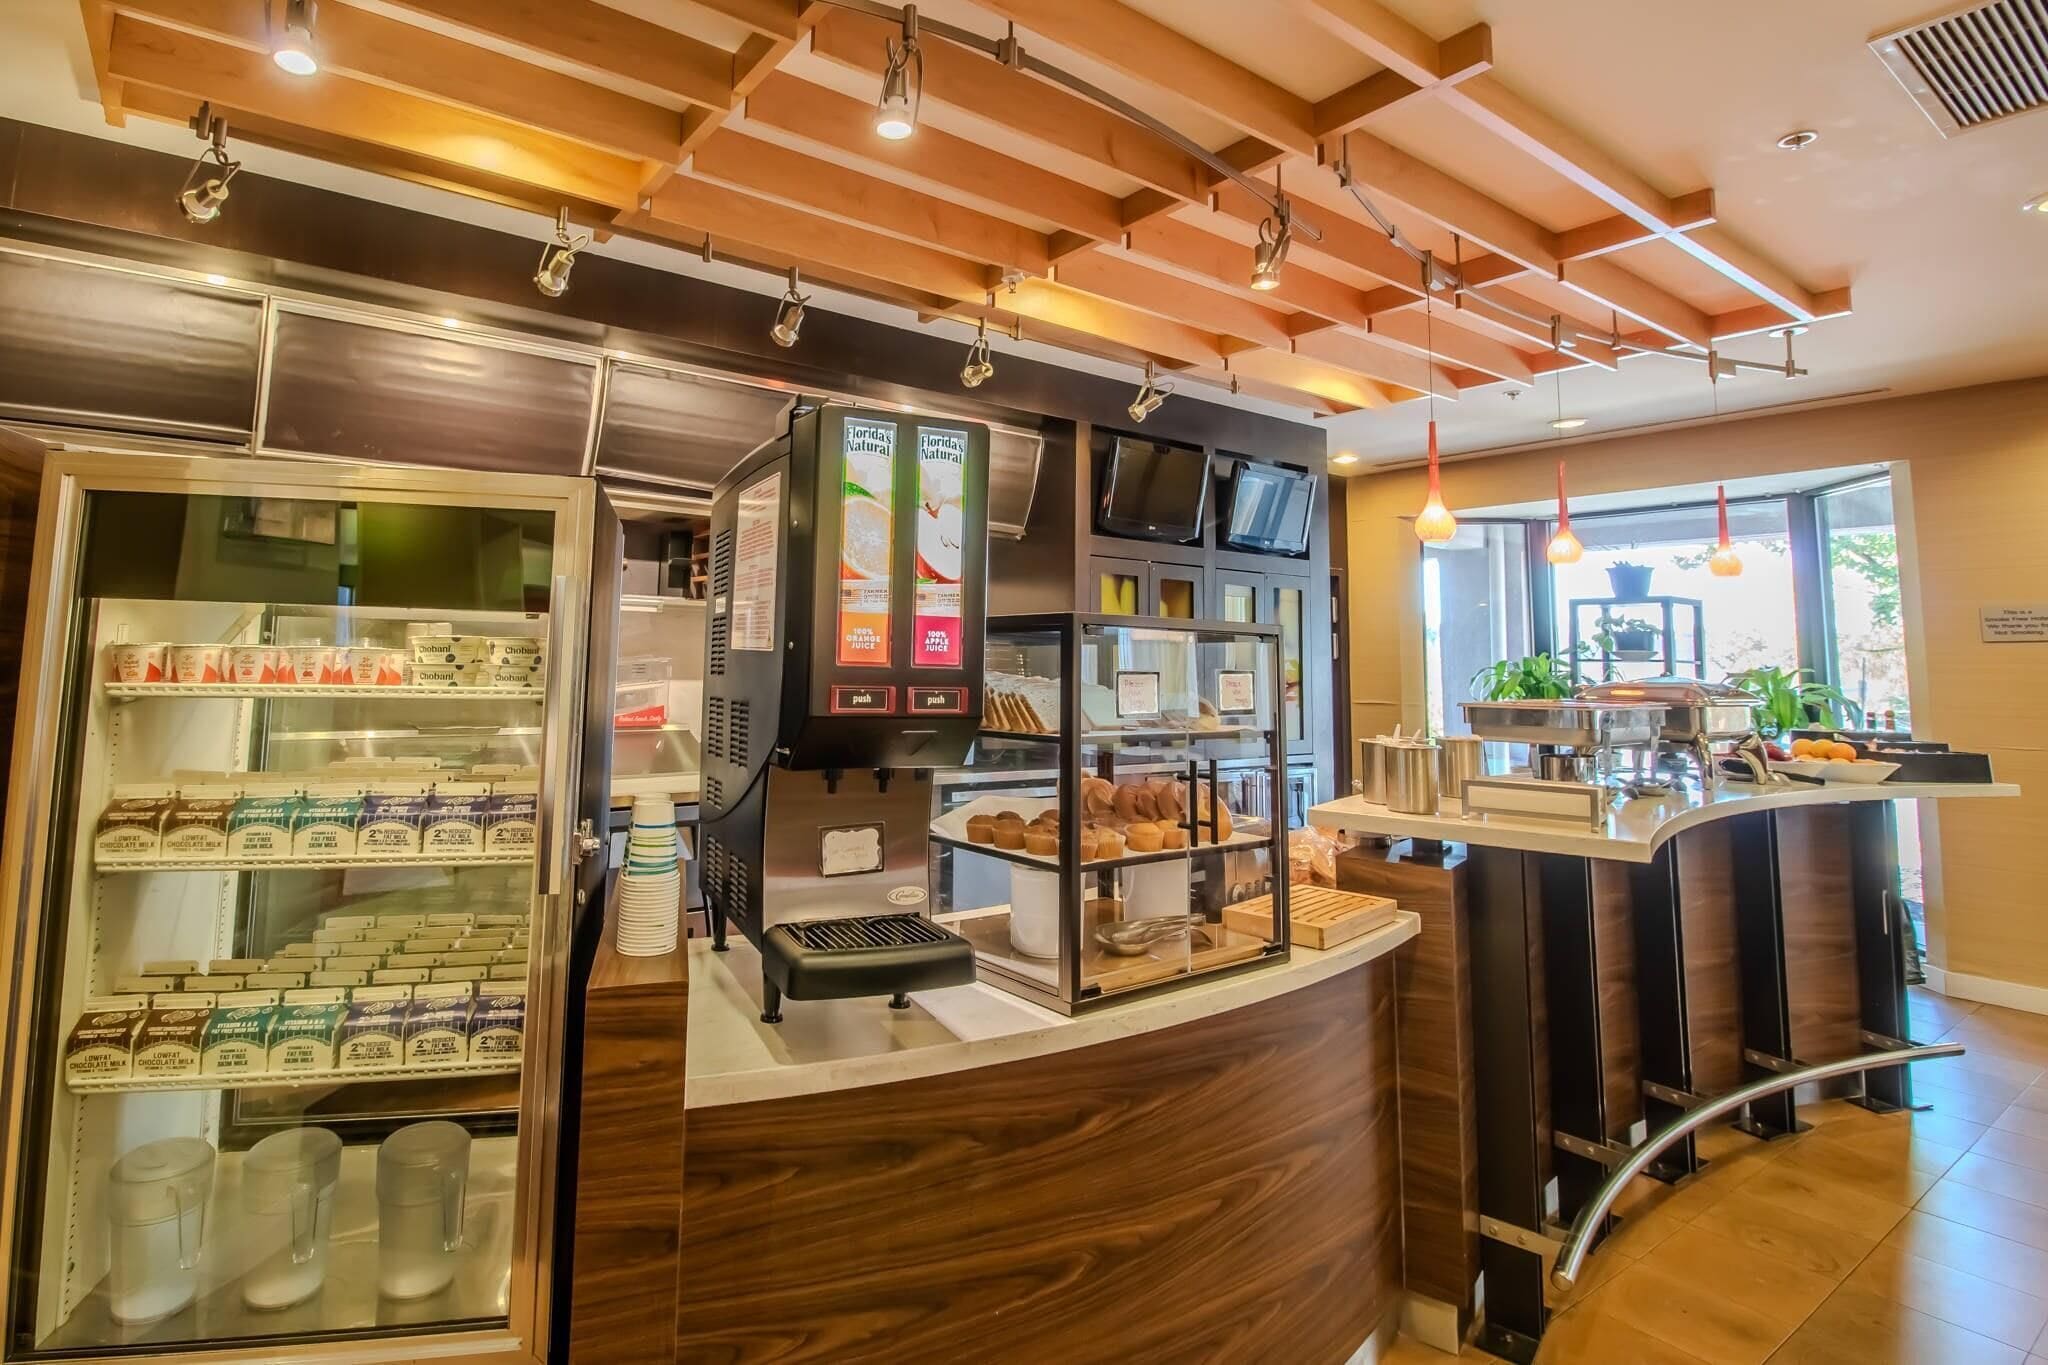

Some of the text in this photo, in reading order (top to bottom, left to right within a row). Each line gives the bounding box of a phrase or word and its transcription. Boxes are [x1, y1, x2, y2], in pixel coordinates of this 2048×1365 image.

[846, 426, 892, 444] Florida's
[846, 439, 890, 457] Natural
[921, 434, 964, 453] Florida's
[921, 447, 962, 465] Natural
[853, 627, 873, 635] 100%
[846, 635, 881, 643] ORANGE
[420, 645, 451, 653] Chobani
[505, 646, 540, 655] Chobani
[851, 642, 875, 650] JUICE
[420, 672, 454, 680] Chobani
[852, 694, 872, 705] push
[927, 695, 945, 706] push
[368, 829, 383, 838] 2%
[433, 829, 448, 838] 2%
[496, 828, 510, 837] 2%
[416, 1038, 431, 1049] 2%
[481, 1035, 496, 1045] 2%
[351, 1042, 365, 1052] 2%
[84, 1054, 111, 1062] LOWFAT
[138, 1058, 177, 1066] CHOCOLATE
[69, 1061, 109, 1070] CHOCOLATE
